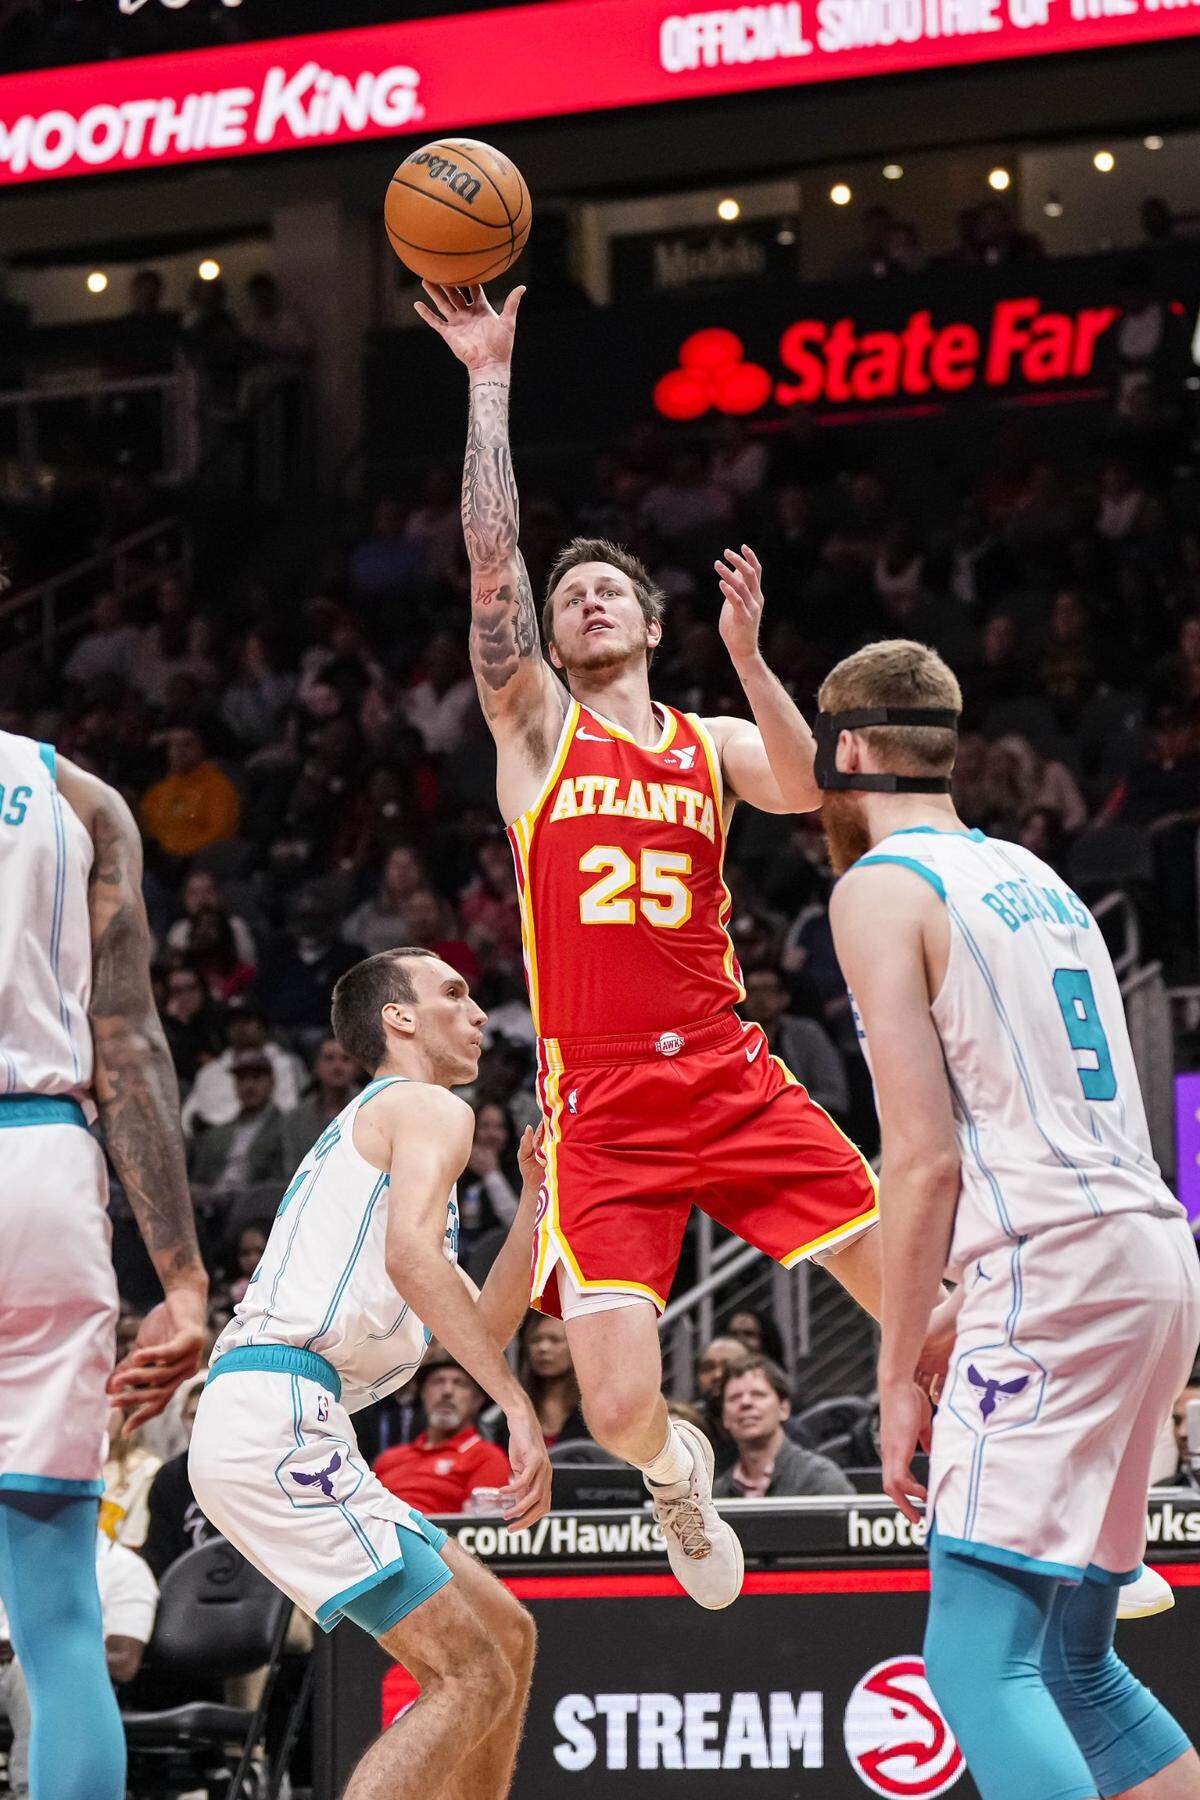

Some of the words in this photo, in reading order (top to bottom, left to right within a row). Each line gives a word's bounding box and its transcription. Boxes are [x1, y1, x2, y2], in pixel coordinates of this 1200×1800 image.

[659, 1, 812, 73] OFFICIAL
[816, 0, 1003, 52] SMOOTHIE
[775, 310, 980, 407] State
[985, 297, 1122, 384] Far
[550, 774, 715, 845] ATLANTA
[578, 844, 693, 929] 25
[655, 1036, 686, 1052] HAWKS
[1052, 968, 1118, 1102] 9
[553, 1691, 823, 1771] STREAM
